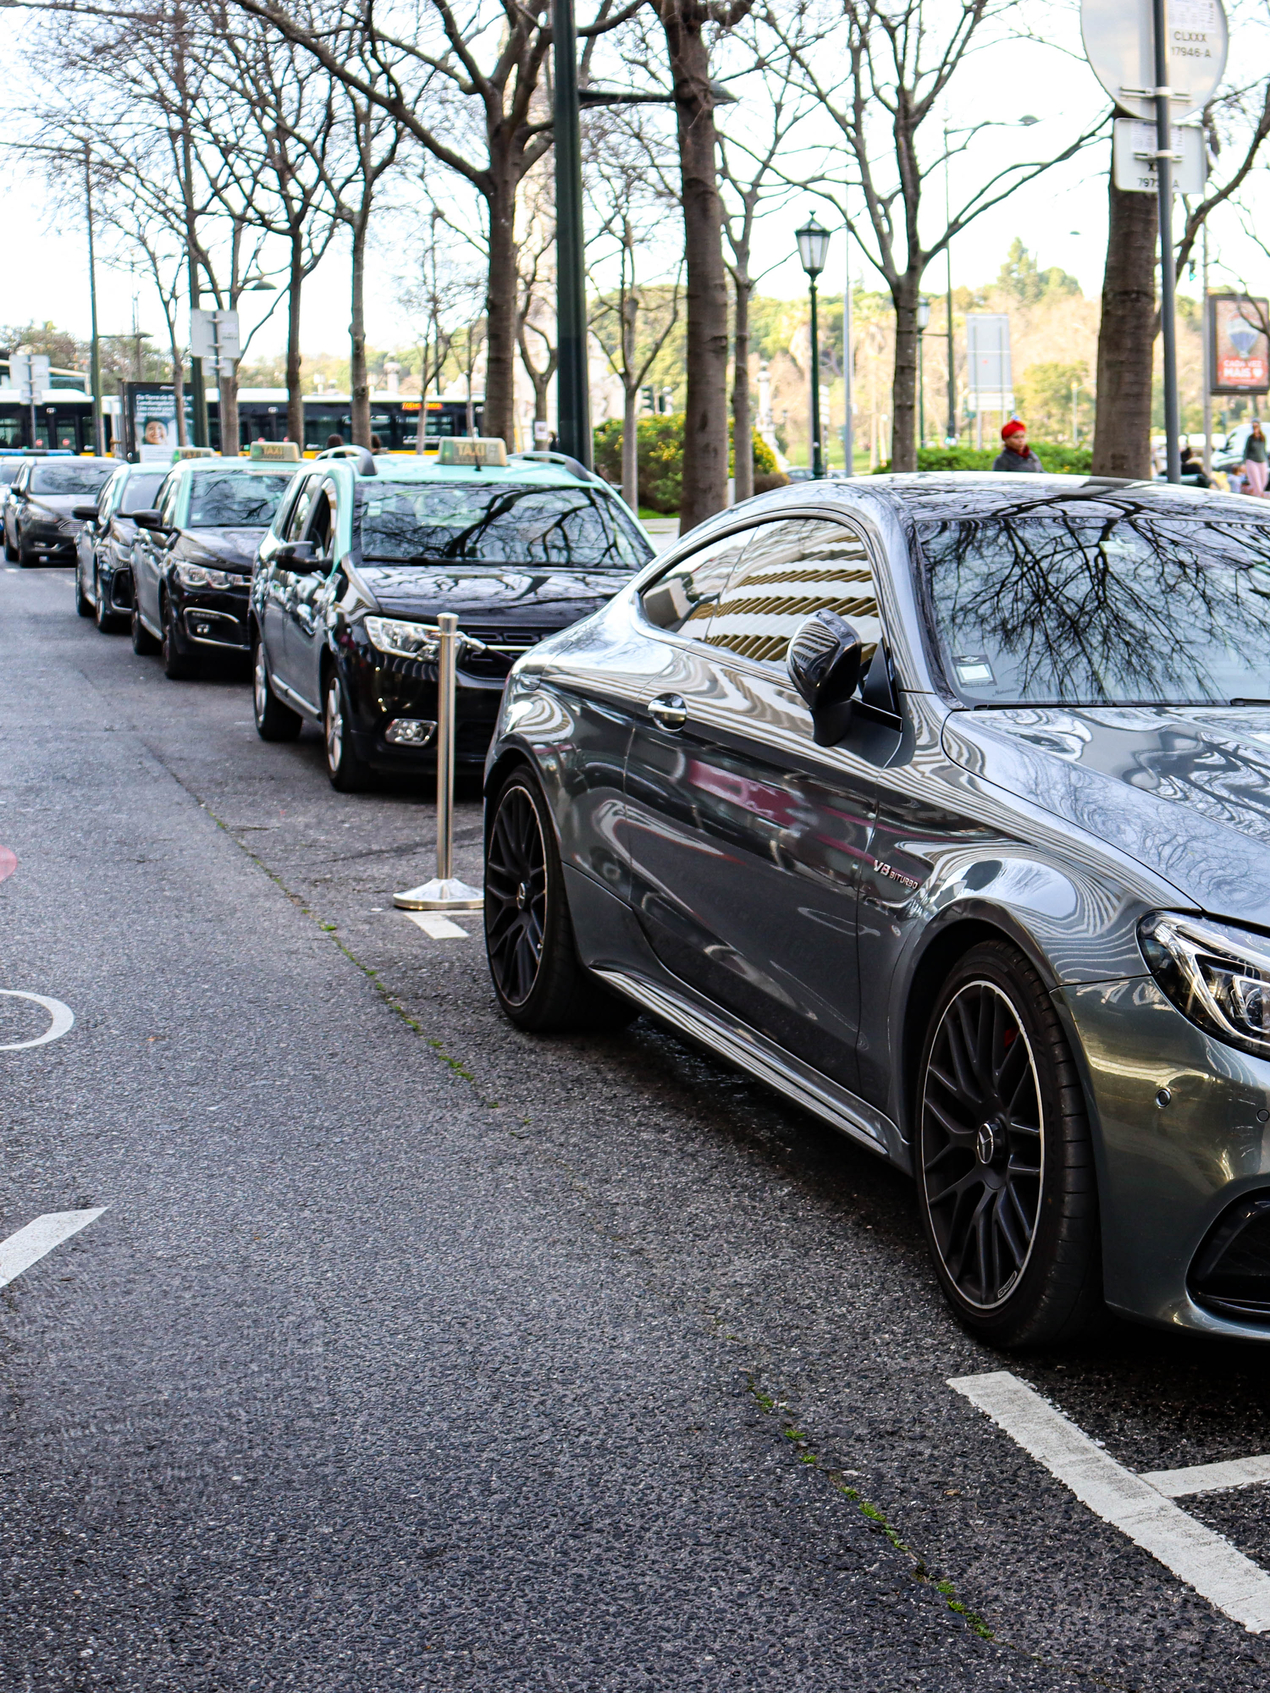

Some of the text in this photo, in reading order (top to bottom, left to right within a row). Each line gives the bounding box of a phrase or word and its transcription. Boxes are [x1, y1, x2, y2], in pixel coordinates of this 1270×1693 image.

[1174, 31, 1207, 42] CLXXX
[1171, 47, 1212, 58] 17946-A
[1223, 368, 1252, 377] MAIS
[262, 446, 284, 455] TAXI
[456, 443, 487, 456] TAXI
[874, 859, 919, 890] V8 BITURBO
